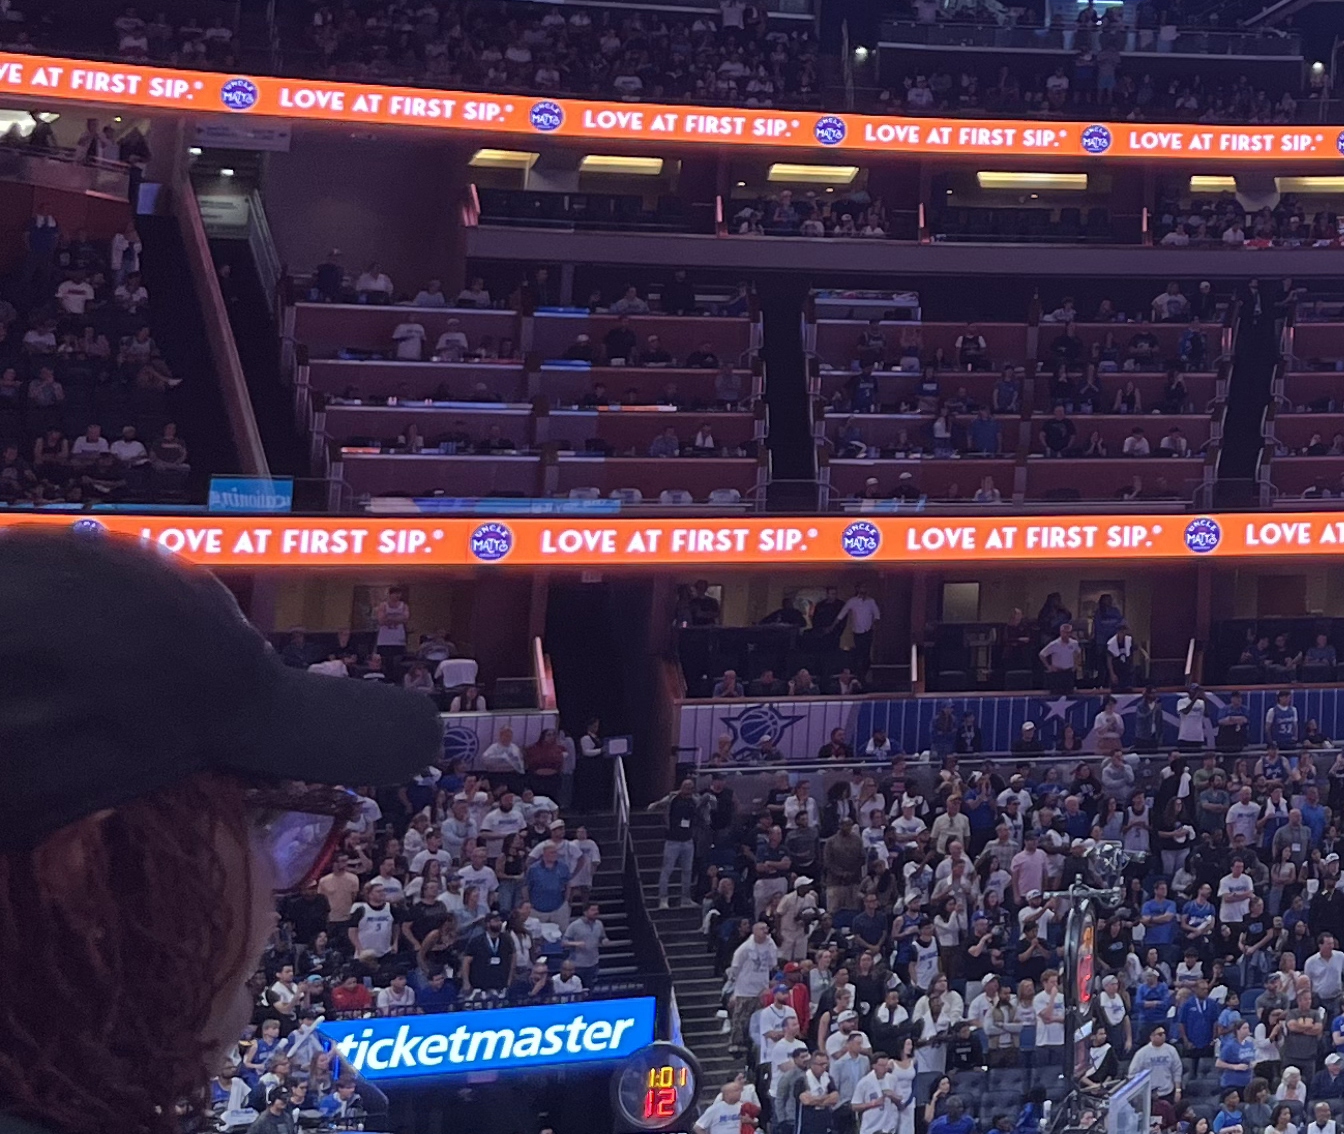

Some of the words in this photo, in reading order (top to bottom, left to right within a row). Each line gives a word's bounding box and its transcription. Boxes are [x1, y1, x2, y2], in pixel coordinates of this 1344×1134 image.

[279, 88, 345, 111] LOVE
[351, 93, 383, 114] AT
[389, 95, 457, 119] FIRST
[541, 529, 617, 553] LOVE
[626, 529, 663, 553] AT
[671, 528, 750, 553] FIRST
[335, 1012, 635, 1072] ticketmaster
[649, 1066, 688, 1088] 1:01
[645, 1088, 676, 1118] 12
